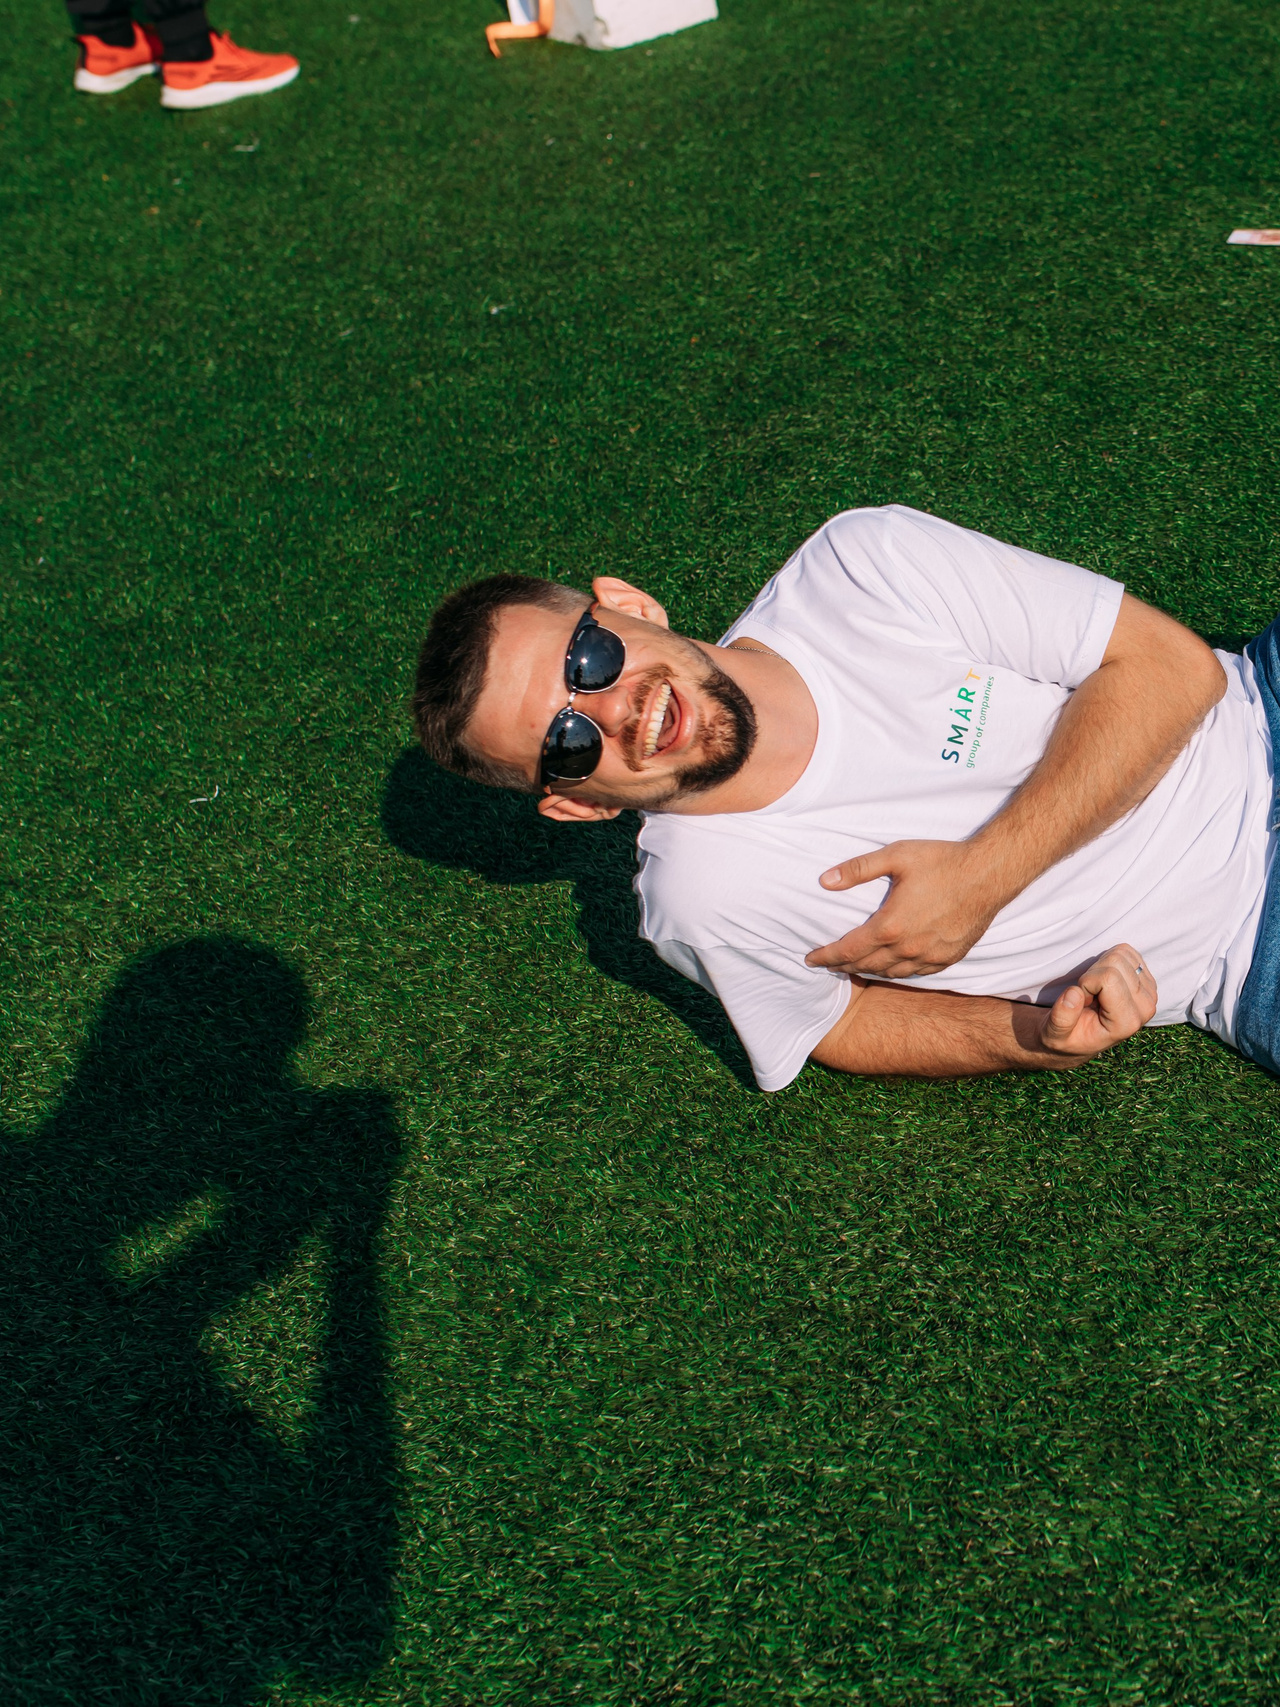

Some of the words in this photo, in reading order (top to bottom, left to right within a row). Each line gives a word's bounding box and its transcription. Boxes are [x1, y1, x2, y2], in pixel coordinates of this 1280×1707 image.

[979, 676, 995, 725] companies
[976, 727, 983, 738] of
[966, 740, 981, 768] group
